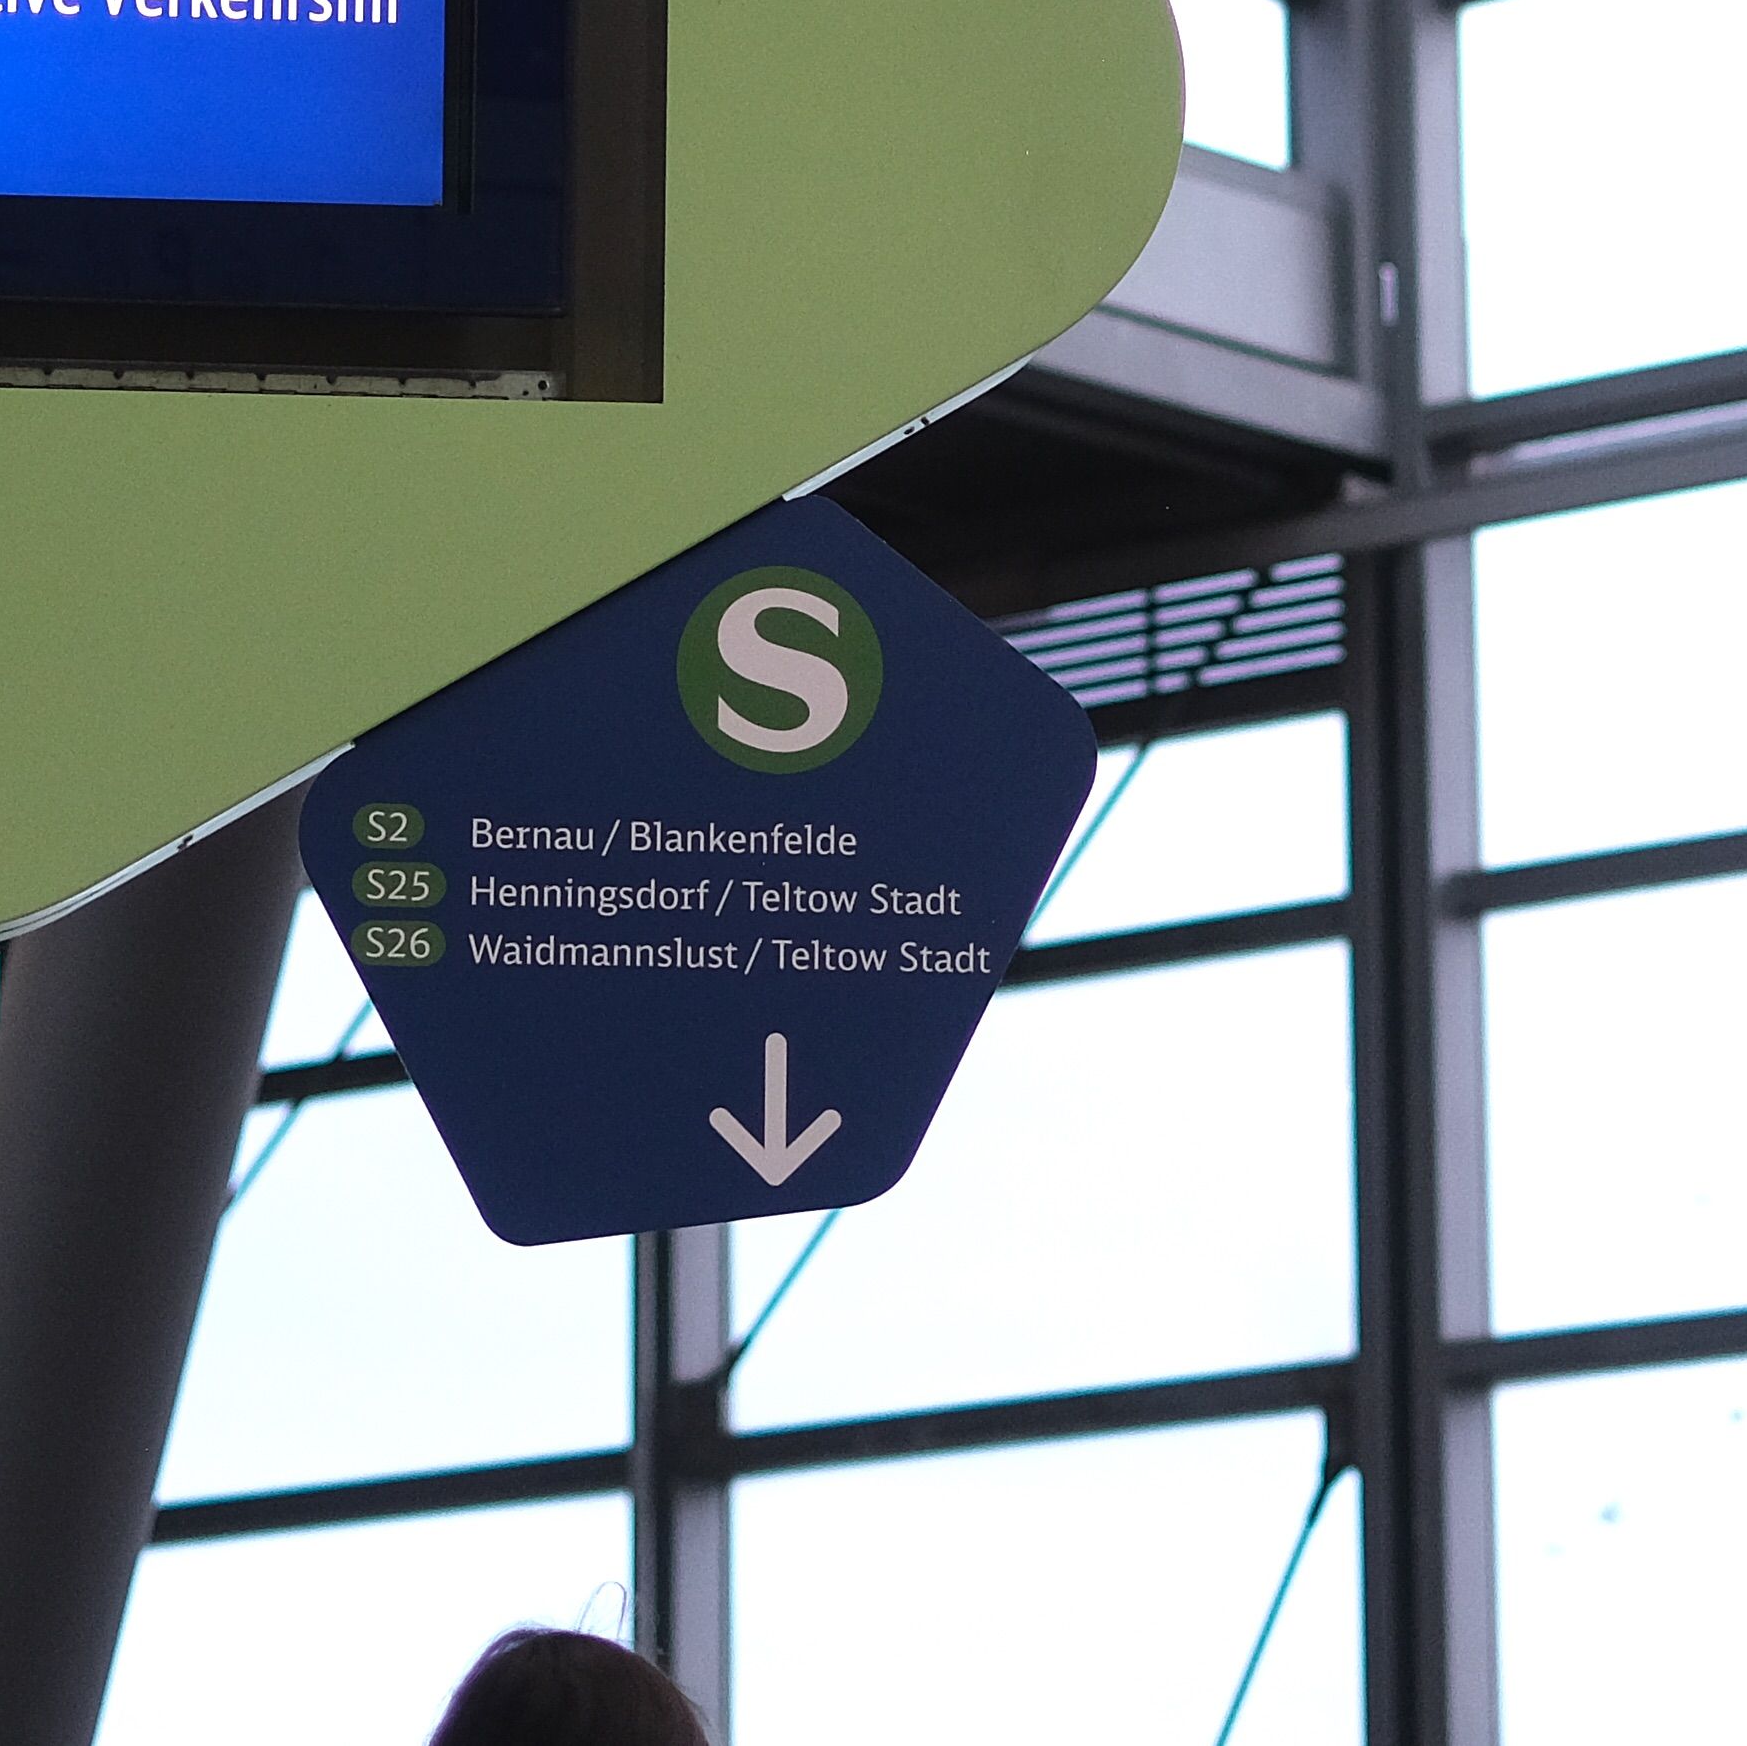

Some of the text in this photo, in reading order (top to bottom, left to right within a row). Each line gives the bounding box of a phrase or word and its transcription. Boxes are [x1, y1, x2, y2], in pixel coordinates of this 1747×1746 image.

[716, 587, 849, 753] S
[366, 810, 409, 843] S2
[470, 817, 594, 851] Bernau
[629, 820, 858, 856] Blankenfelde
[365, 868, 431, 902] S25
[469, 875, 710, 917] Henningsdorf
[741, 881, 858, 914] Teltow
[869, 883, 962, 916] Stadt
[364, 926, 432, 960] S26
[468, 933, 739, 971] Waidmannslust
[771, 939, 888, 972] Teltow
[899, 941, 993, 975] Stadt
